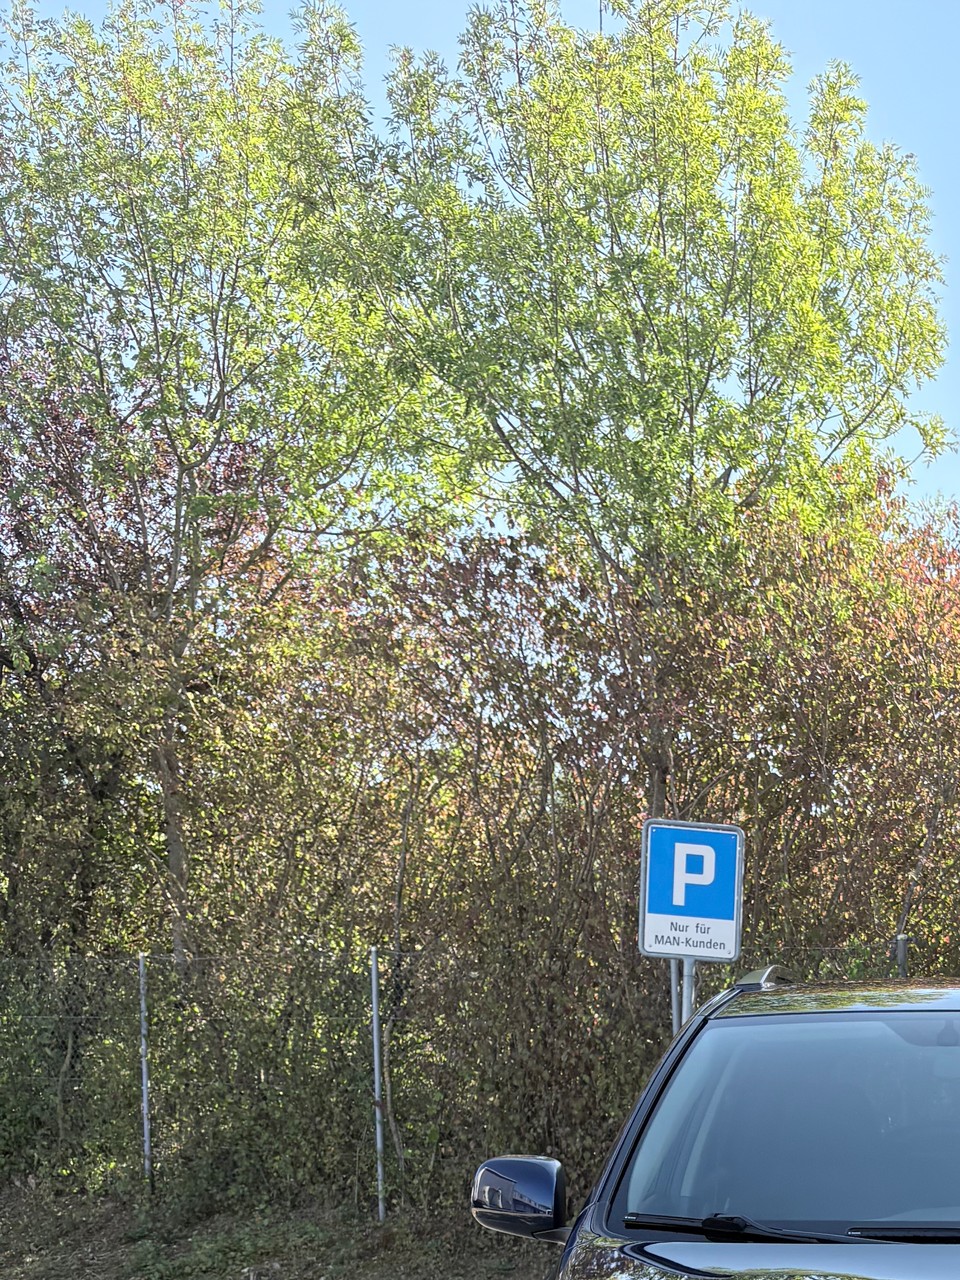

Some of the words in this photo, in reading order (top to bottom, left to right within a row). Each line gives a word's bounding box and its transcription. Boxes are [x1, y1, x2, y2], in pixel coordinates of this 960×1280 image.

[672, 842, 716, 906] P
[669, 921, 690, 933] Nur
[695, 923, 711, 934] für
[654, 934, 726, 950] MAN-Kunden
